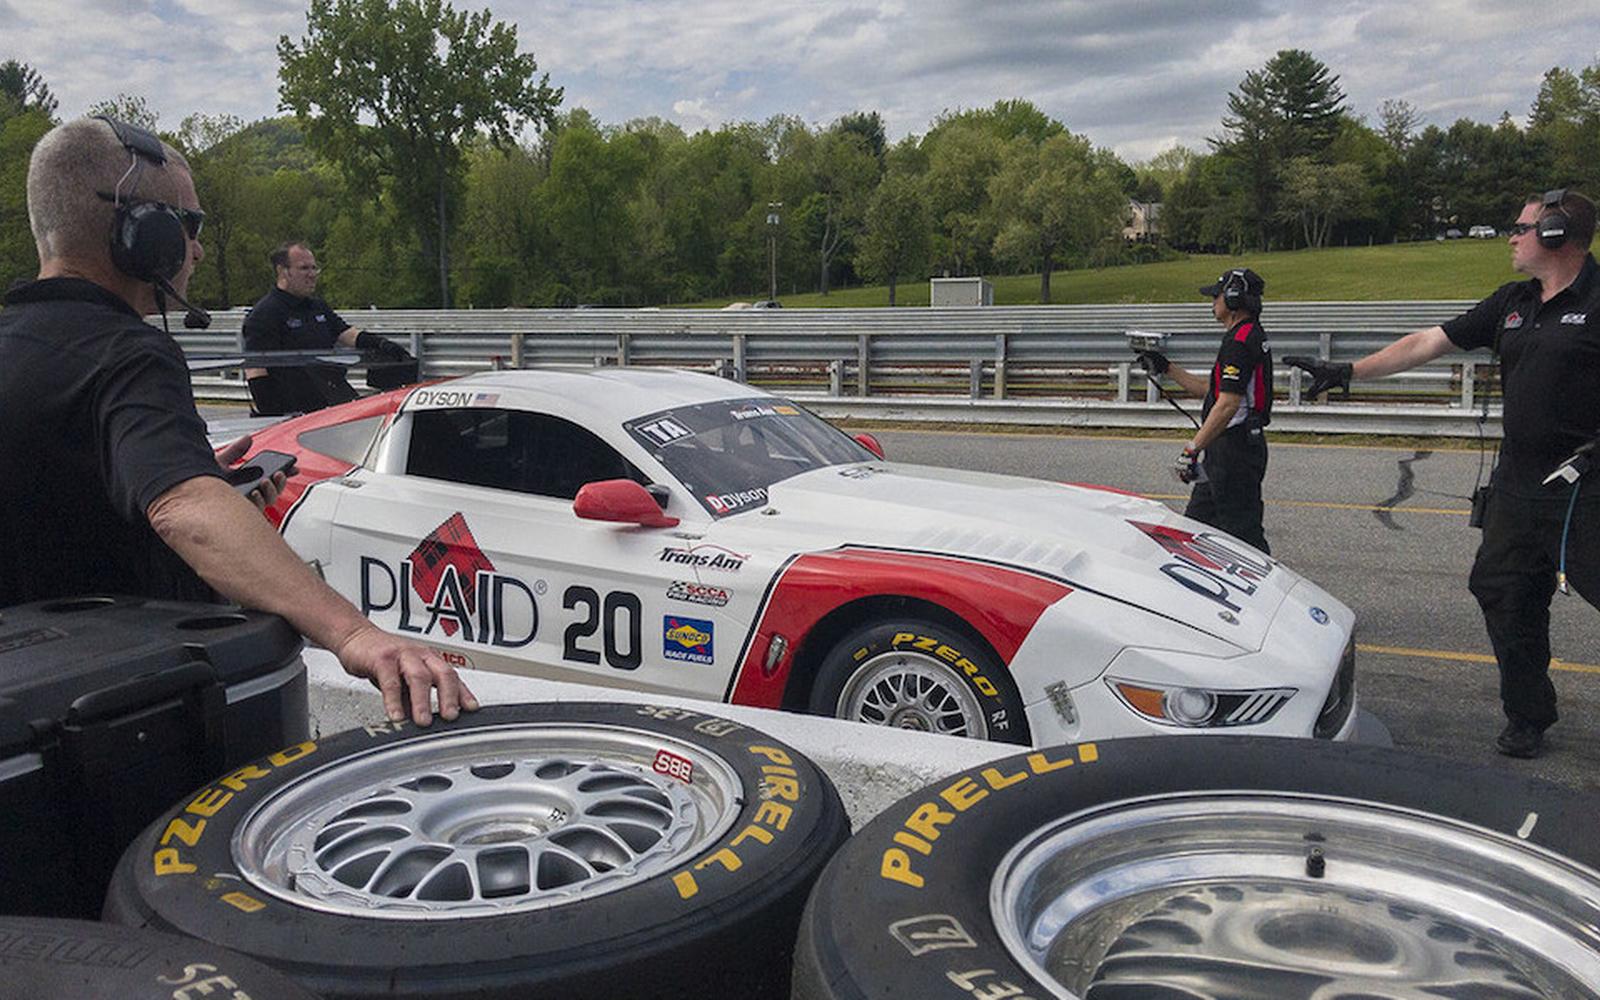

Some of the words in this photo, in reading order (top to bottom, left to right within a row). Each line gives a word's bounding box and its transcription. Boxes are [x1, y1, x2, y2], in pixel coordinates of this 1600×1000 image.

[415, 390, 473, 406] DYSON
[643, 419, 689, 442] TA
[719, 487, 768, 510] Dyson
[659, 547, 710, 566] Trans
[708, 553, 744, 570] Am
[687, 584, 728, 599] SCCA
[563, 585, 642, 671] 20
[668, 627, 709, 642] SUNOCO
[891, 632, 998, 697] PZERO
[636, 704, 698, 722] SET
[992, 709, 1009, 731] RF
[154, 740, 318, 876] PZERO
[880, 742, 1099, 888] PIRELLI
[672, 745, 800, 900] PIRELLI
